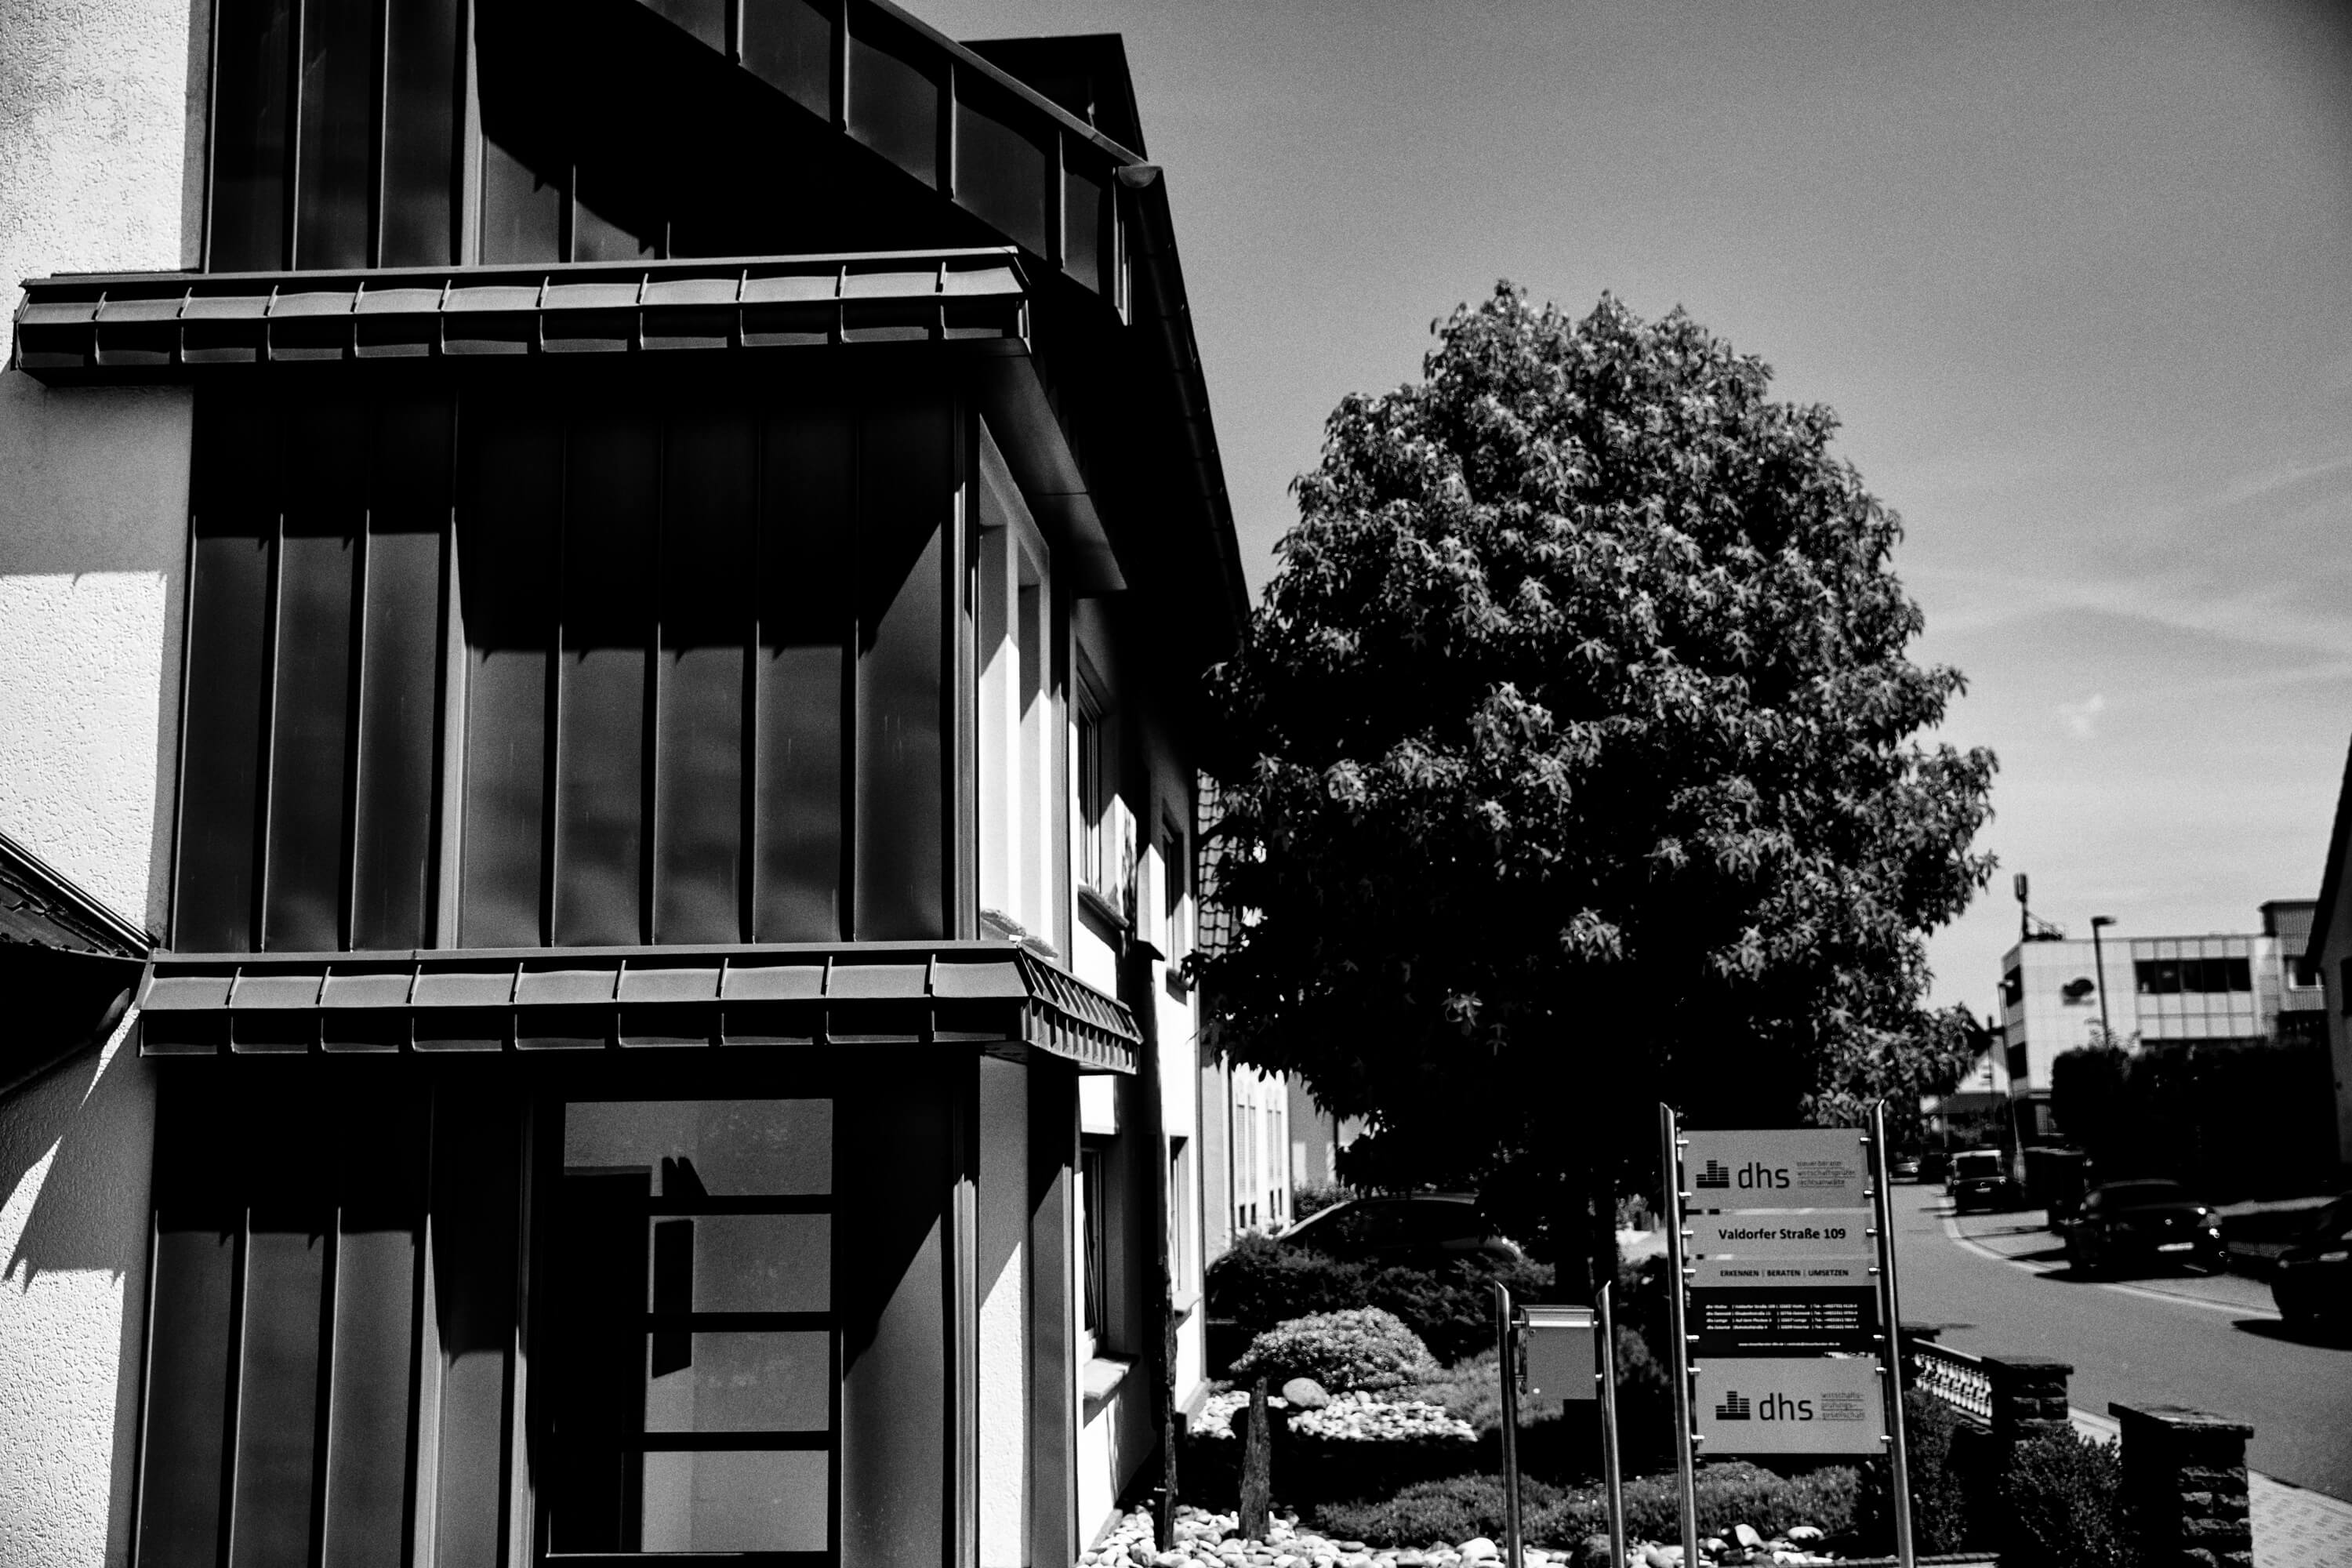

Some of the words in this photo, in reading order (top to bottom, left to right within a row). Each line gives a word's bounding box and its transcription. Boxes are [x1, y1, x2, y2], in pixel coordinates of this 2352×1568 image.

[1737, 1161, 1791, 1189] dhs
[1718, 1228, 1777, 1240] Valdorfer
[1779, 1227, 1820, 1240] Straße
[1824, 1228, 1846, 1240] 109
[1808, 1269, 1849, 1277] UMSETZEN
[1759, 1392, 1813, 1421] dhs
